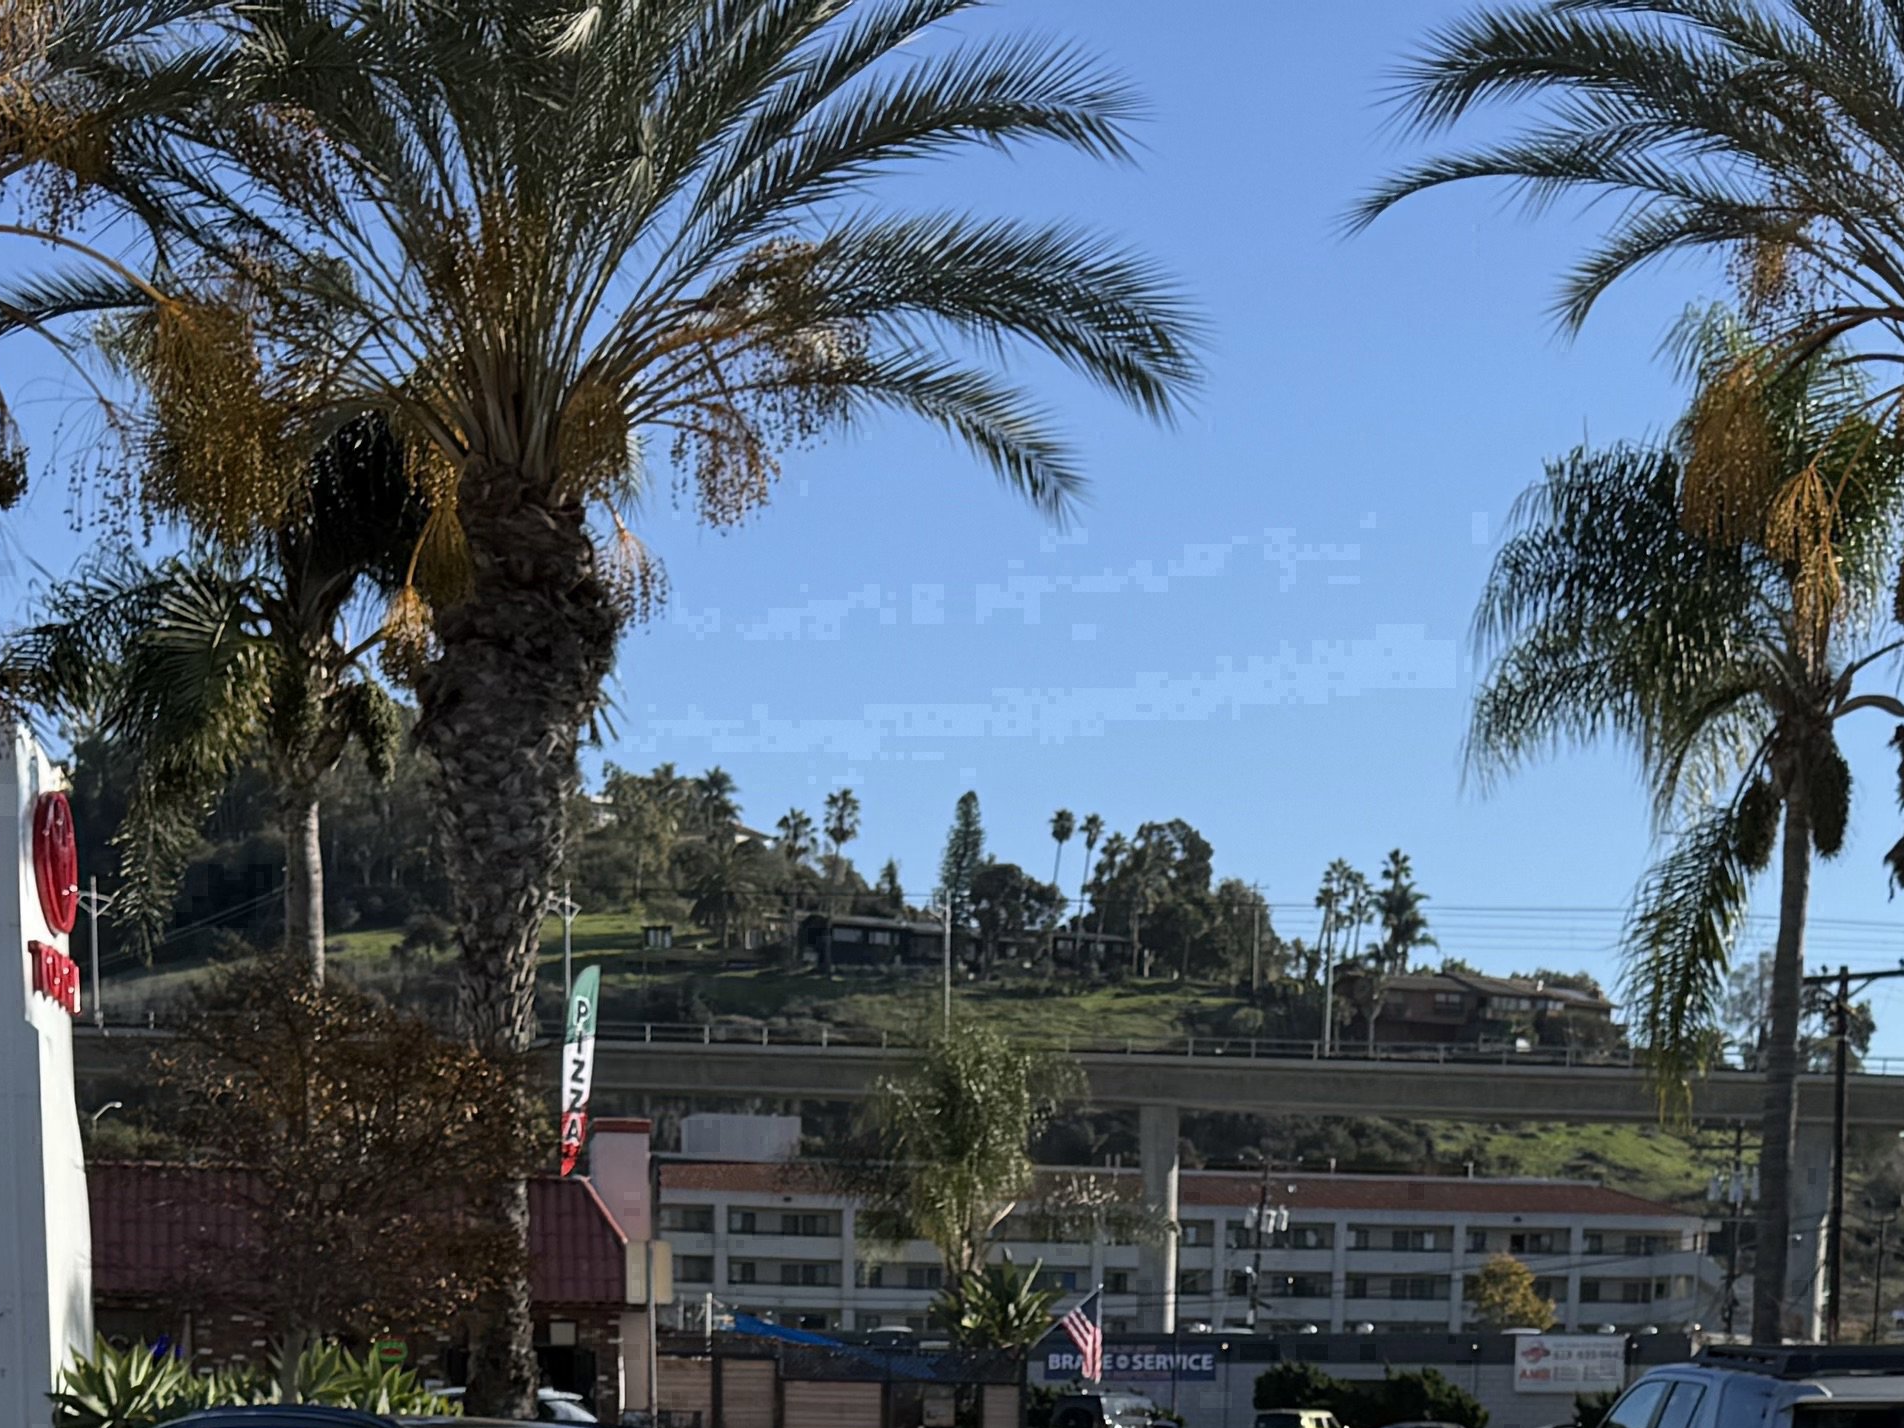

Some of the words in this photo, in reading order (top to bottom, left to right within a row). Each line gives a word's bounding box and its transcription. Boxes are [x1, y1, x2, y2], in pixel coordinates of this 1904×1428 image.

[565, 1000, 588, 1141] PIZZA
[1048, 1353, 1113, 1371] BRAE
[1131, 1353, 1214, 1371] SERVICE
